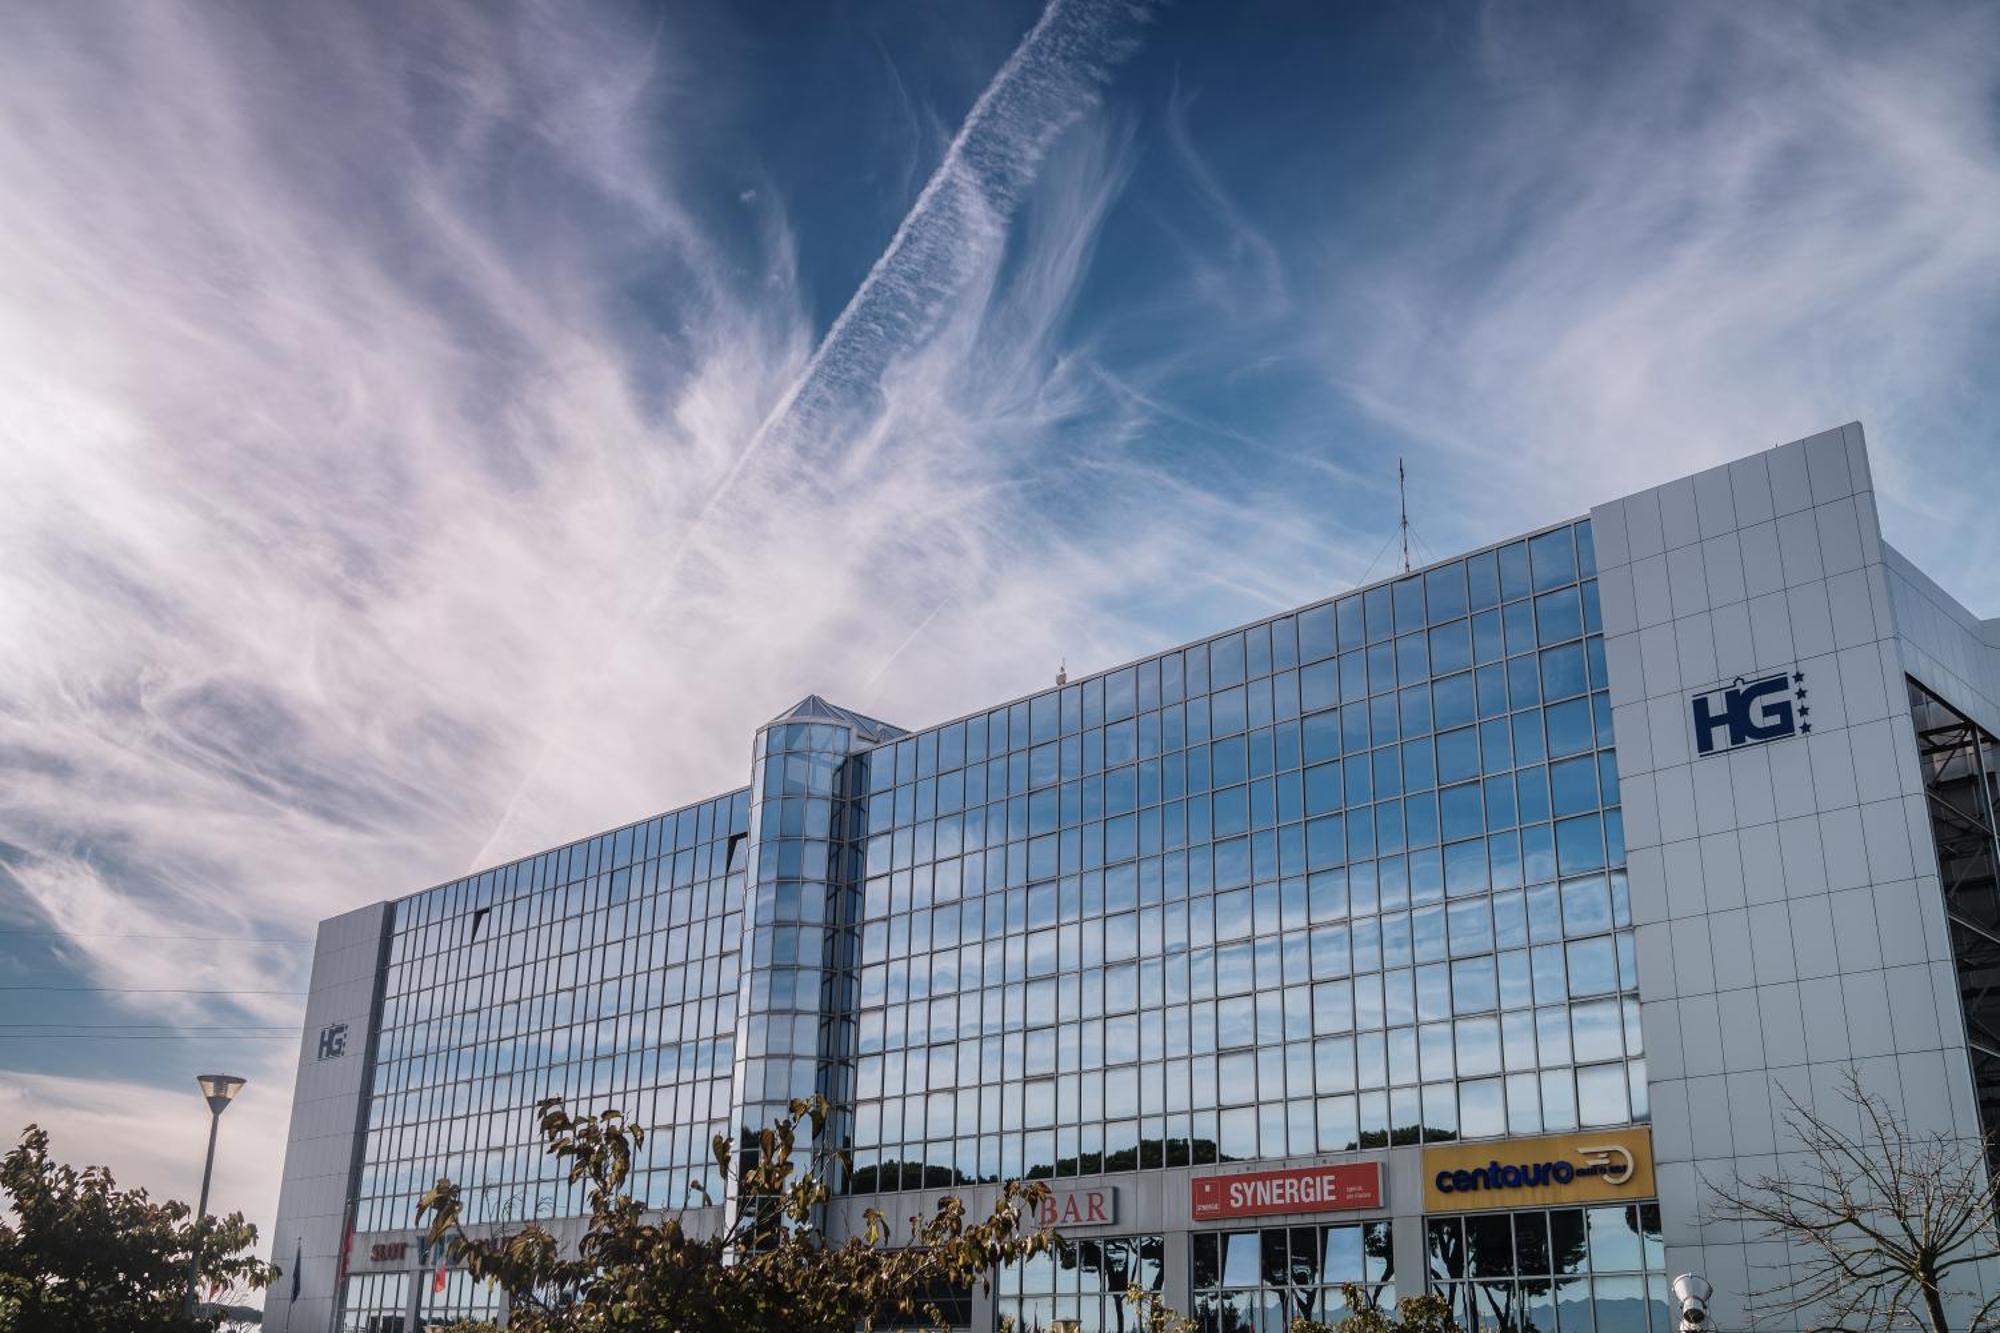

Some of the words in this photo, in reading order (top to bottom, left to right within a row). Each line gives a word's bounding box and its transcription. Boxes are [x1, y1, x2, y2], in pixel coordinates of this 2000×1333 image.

[1692, 676, 1796, 754] HG
[318, 1025, 345, 1059] HG
[1230, 1174, 1337, 1208] SYNERGIE
[1435, 1160, 1574, 1194] centauro
[1039, 1192, 1108, 1226] BAR
